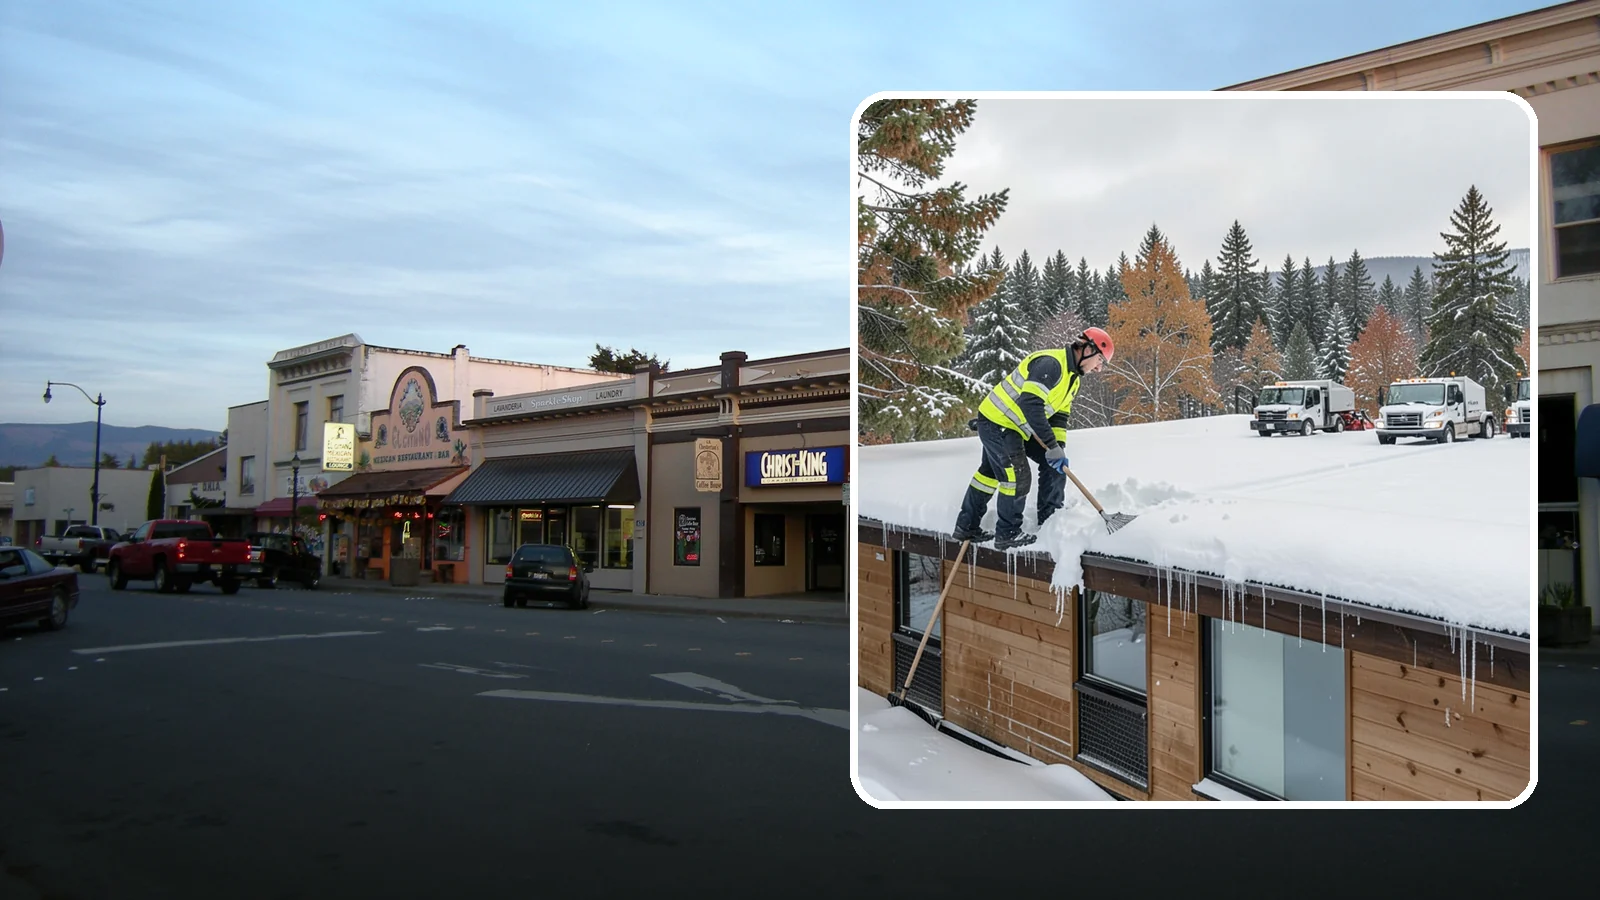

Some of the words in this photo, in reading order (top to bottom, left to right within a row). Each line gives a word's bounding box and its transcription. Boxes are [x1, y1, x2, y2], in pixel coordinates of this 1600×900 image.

[494, 402, 522, 412] LAVANDERIA
[530, 396, 559, 409] Sparkle
[562, 394, 582, 405] Shop
[595, 389, 623, 400] LAUNDRY
[373, 455, 396, 464] MEXICAN
[397, 452, 433, 462] RESTAURANT
[437, 450, 450, 459] BAR
[760, 452, 797, 478] CHRIST
[799, 450, 828, 476] KING
